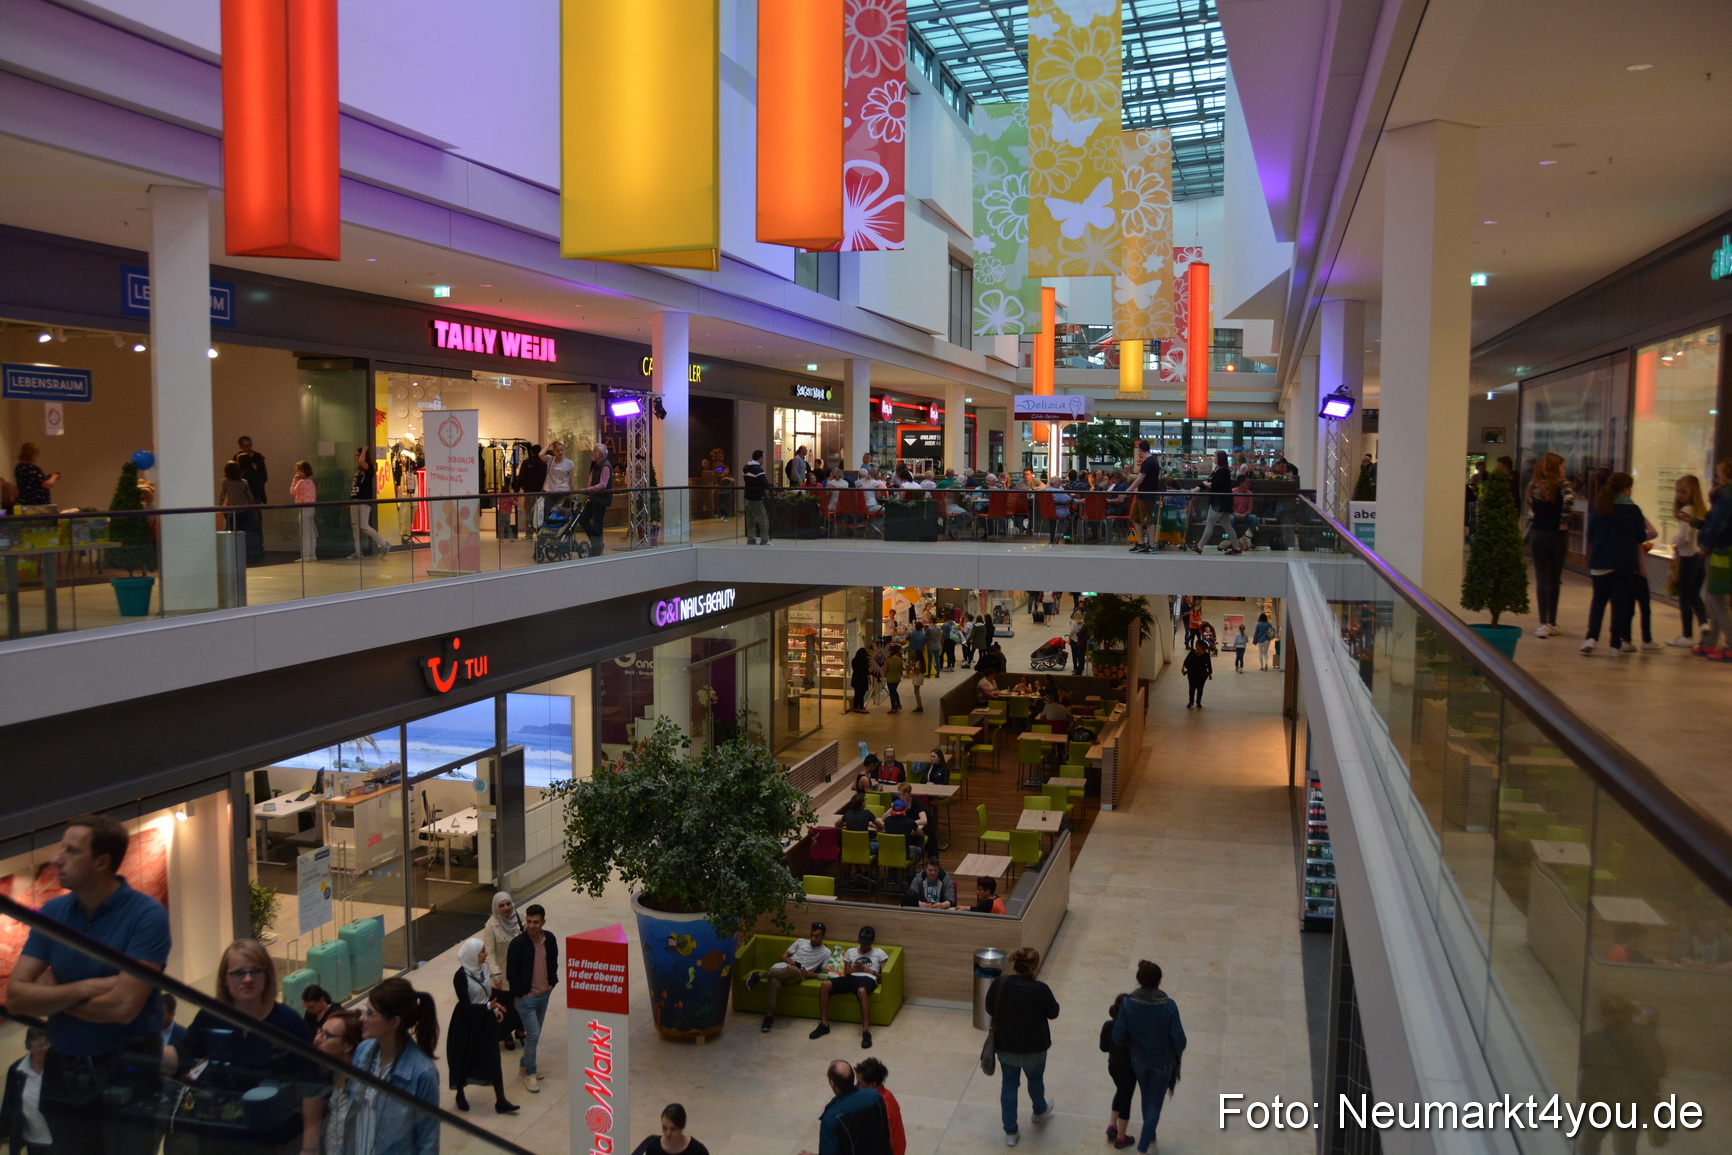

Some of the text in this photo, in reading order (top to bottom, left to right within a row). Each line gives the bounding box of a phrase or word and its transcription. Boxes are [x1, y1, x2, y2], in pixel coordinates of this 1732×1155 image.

[434, 319, 497, 355] TALLY
[11, 375, 84, 391] LEBENSRAUM
[1016, 399, 1066, 411] Delizia
[655, 588, 736, 627] G&T NAILS-BEAUTY
[464, 654, 489, 680] TUI
[567, 958, 626, 973] Sie finden uns
[568, 968, 625, 983] in der Oberen
[570, 980, 623, 995] Ladenstraße
[584, 1019, 613, 1115] Markt
